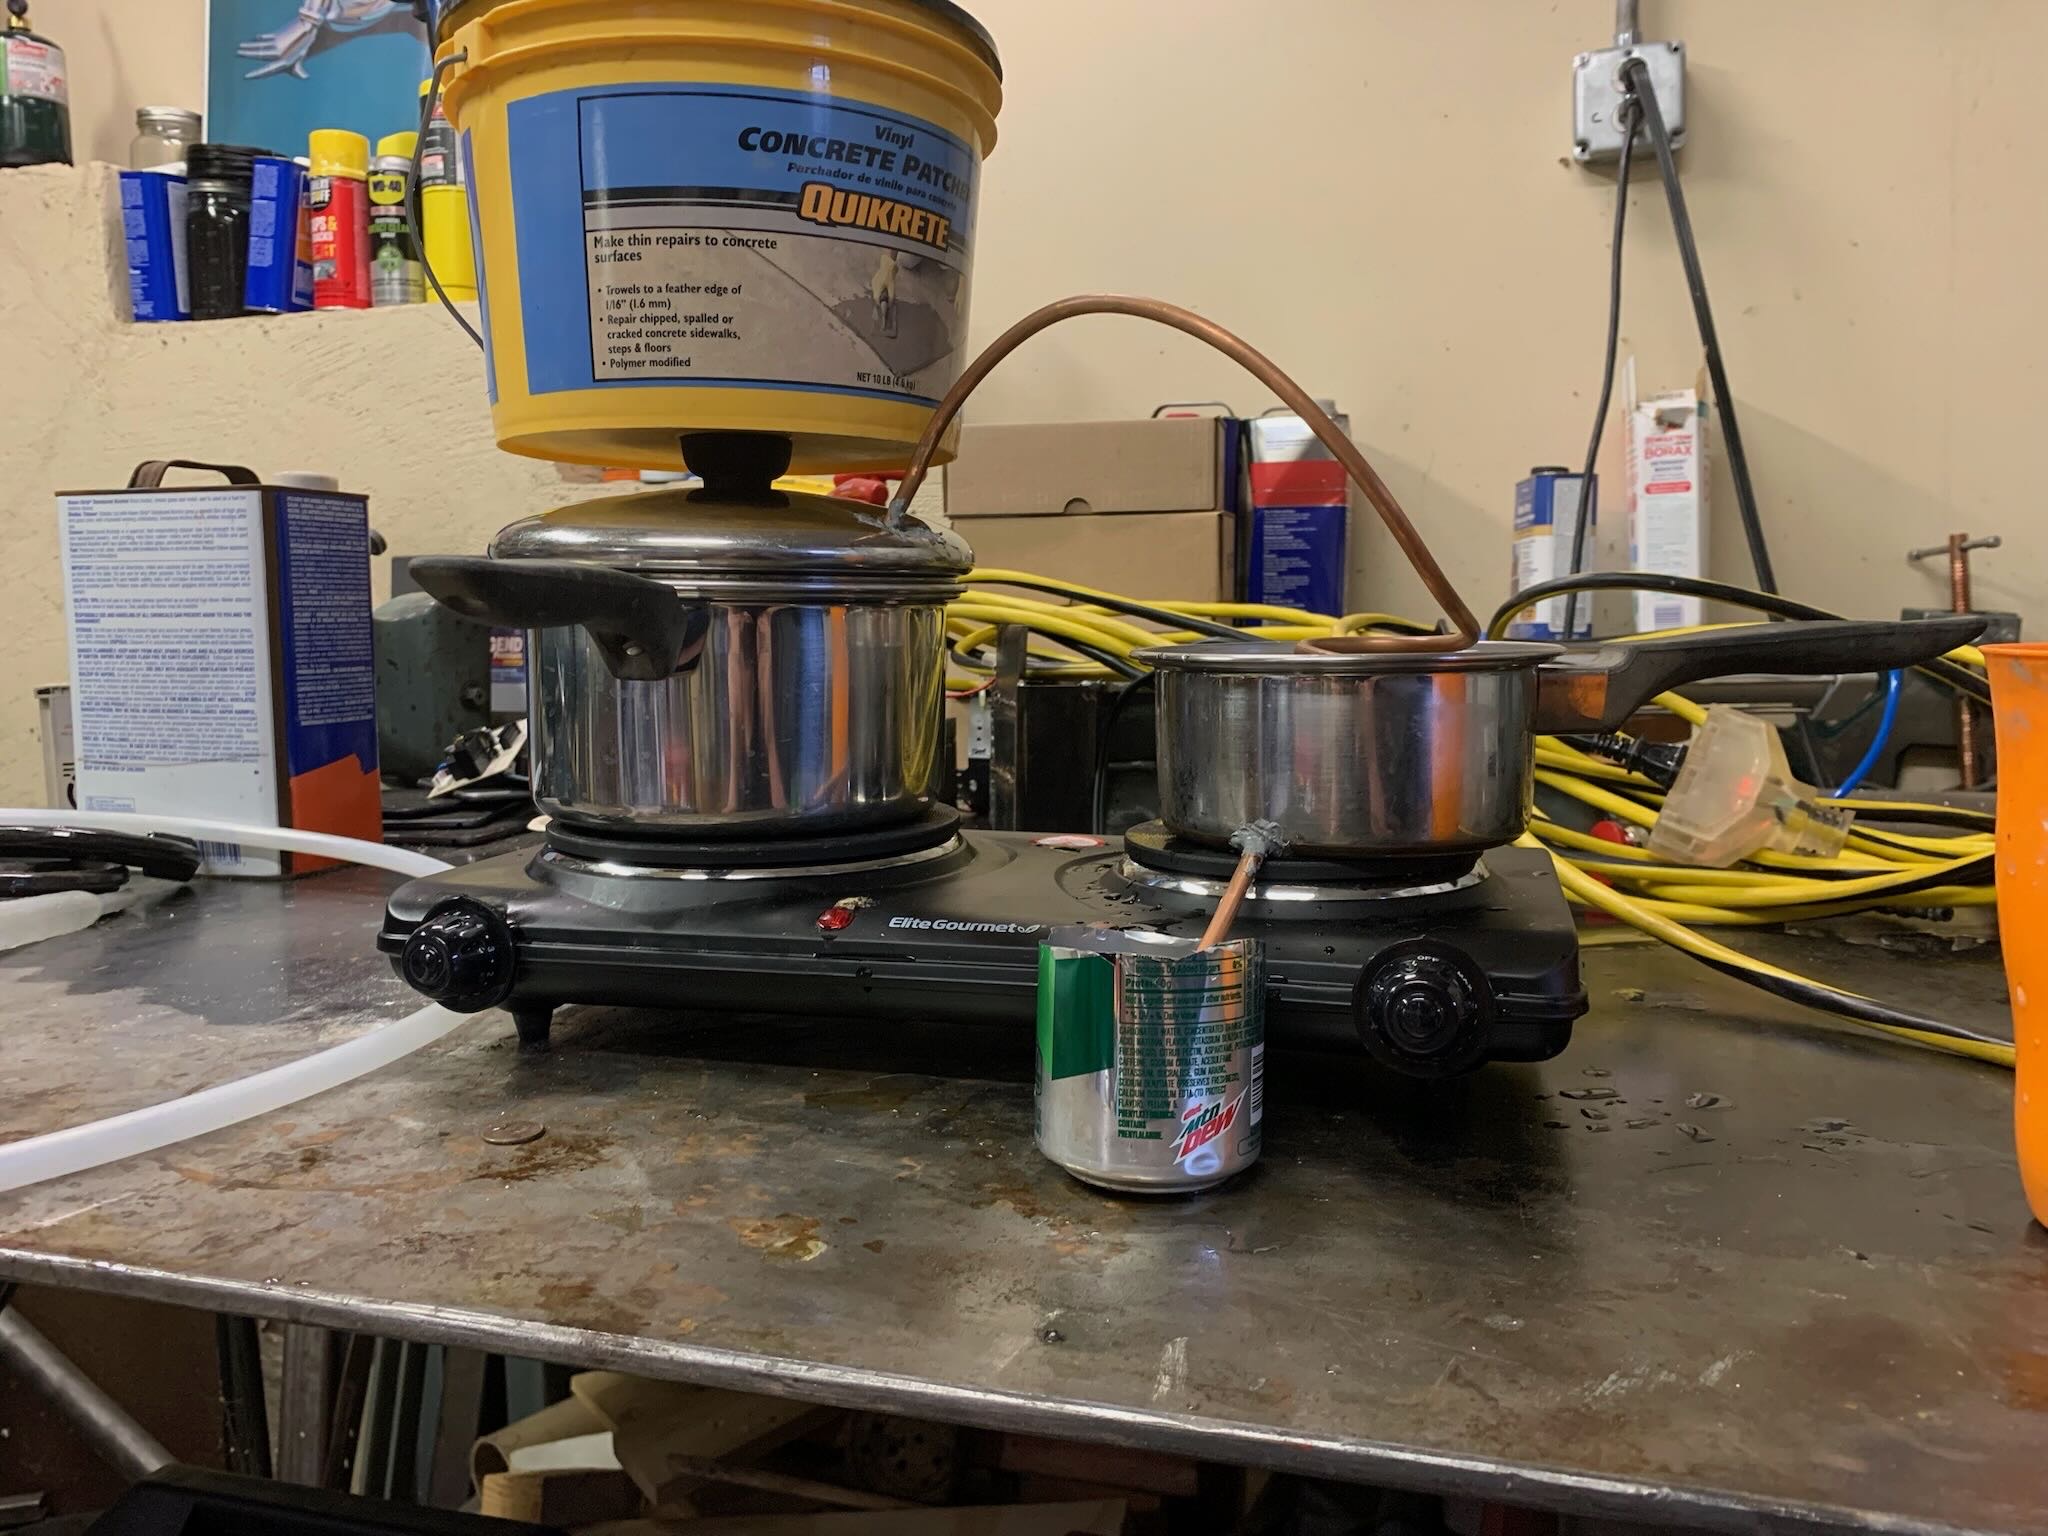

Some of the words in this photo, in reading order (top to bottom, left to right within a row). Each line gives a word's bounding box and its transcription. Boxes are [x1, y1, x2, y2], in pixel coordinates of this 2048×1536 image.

[874, 125, 915, 149] Vinyl
[738, 127, 897, 172] CONCRETE
[857, 172, 872, 184] de
[905, 185, 927, 199] para
[799, 182, 950, 249] QUIKRETE
[594, 236, 624, 249] Make
[627, 234, 651, 247] thin
[655, 233, 701, 248] repairs
[705, 235, 718, 246] to
[722, 237, 777, 249] concrete
[594, 250, 642, 264] surfaces
[606, 283, 641, 295] Trowels
[643, 284, 654, 294] to
[656, 286, 663, 294] a
[665, 283, 702, 294] feather
[704, 284, 729, 297] edge
[731, 284, 743, 295] of
[648, 299, 671, 311] mm)
[607, 313, 637, 327] Repair
[639, 313, 681, 326] chipped,
[683, 313, 719, 325] spalled
[721, 316, 734, 325] or
[607, 327, 643, 340] cracked
[645, 327, 687, 339] concrete
[690, 327, 741, 341] sidewalks,
[608, 343, 632, 356] steps
[634, 342, 642, 353] &
[643, 342, 672, 353] floors
[610, 356, 647, 370] Polymer
[649, 356, 691, 368] modified
[856, 371, 871, 383] NET
[873, 374, 881, 385] 10
[882, 375, 891, 386] LB
[888, 916, 931, 930] Elite
[932, 919, 1016, 934] Gourmet
